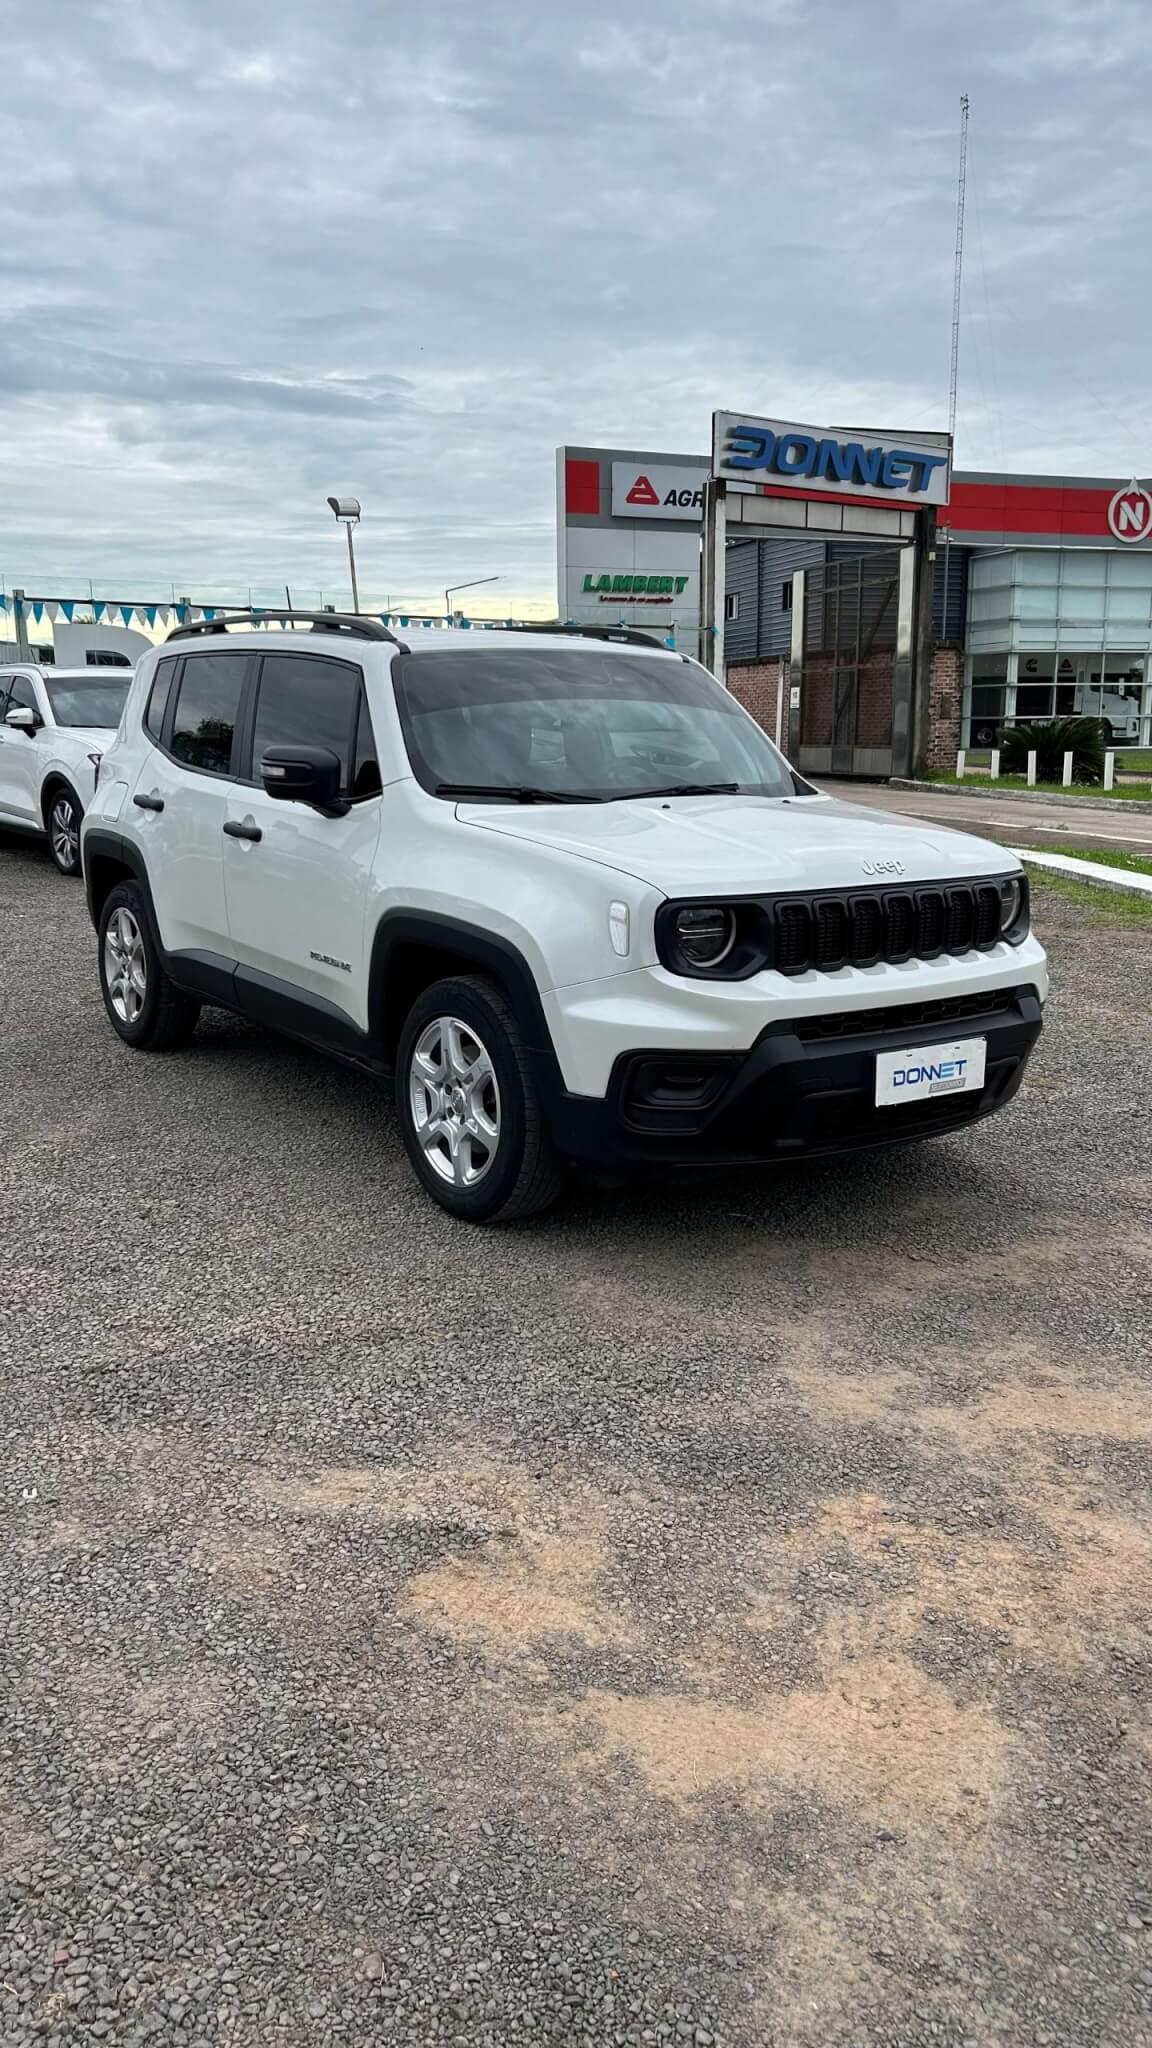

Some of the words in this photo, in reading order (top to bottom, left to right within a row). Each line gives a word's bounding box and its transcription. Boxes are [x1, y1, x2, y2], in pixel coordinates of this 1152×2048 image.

[730, 425, 948, 492] DONNET
[583, 574, 688, 594] LAMBERT
[862, 859, 905, 875] Jeep
[893, 1060, 967, 1087] DONNET
